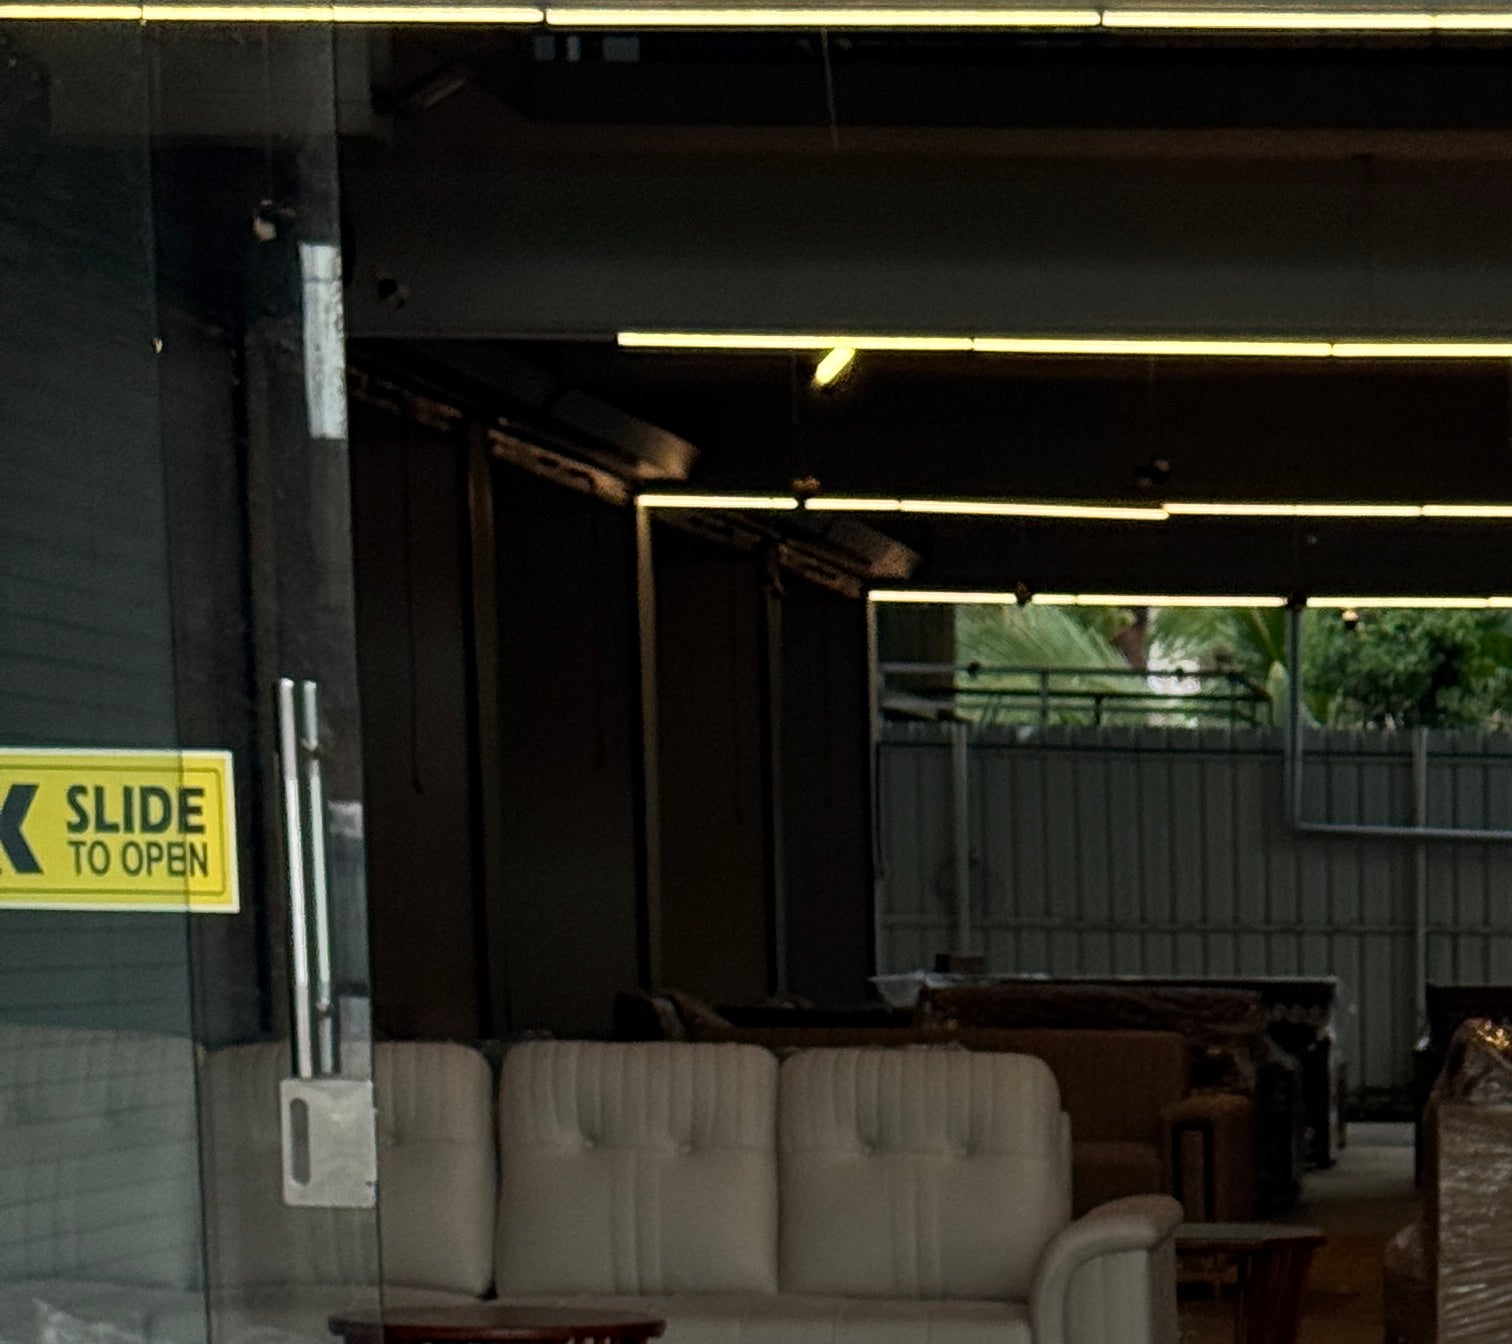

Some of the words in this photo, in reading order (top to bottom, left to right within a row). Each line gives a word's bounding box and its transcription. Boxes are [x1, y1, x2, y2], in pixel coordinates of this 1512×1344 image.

[66, 785, 206, 834] SLIDE
[67, 841, 111, 876] TO
[121, 841, 208, 878] OPEN
